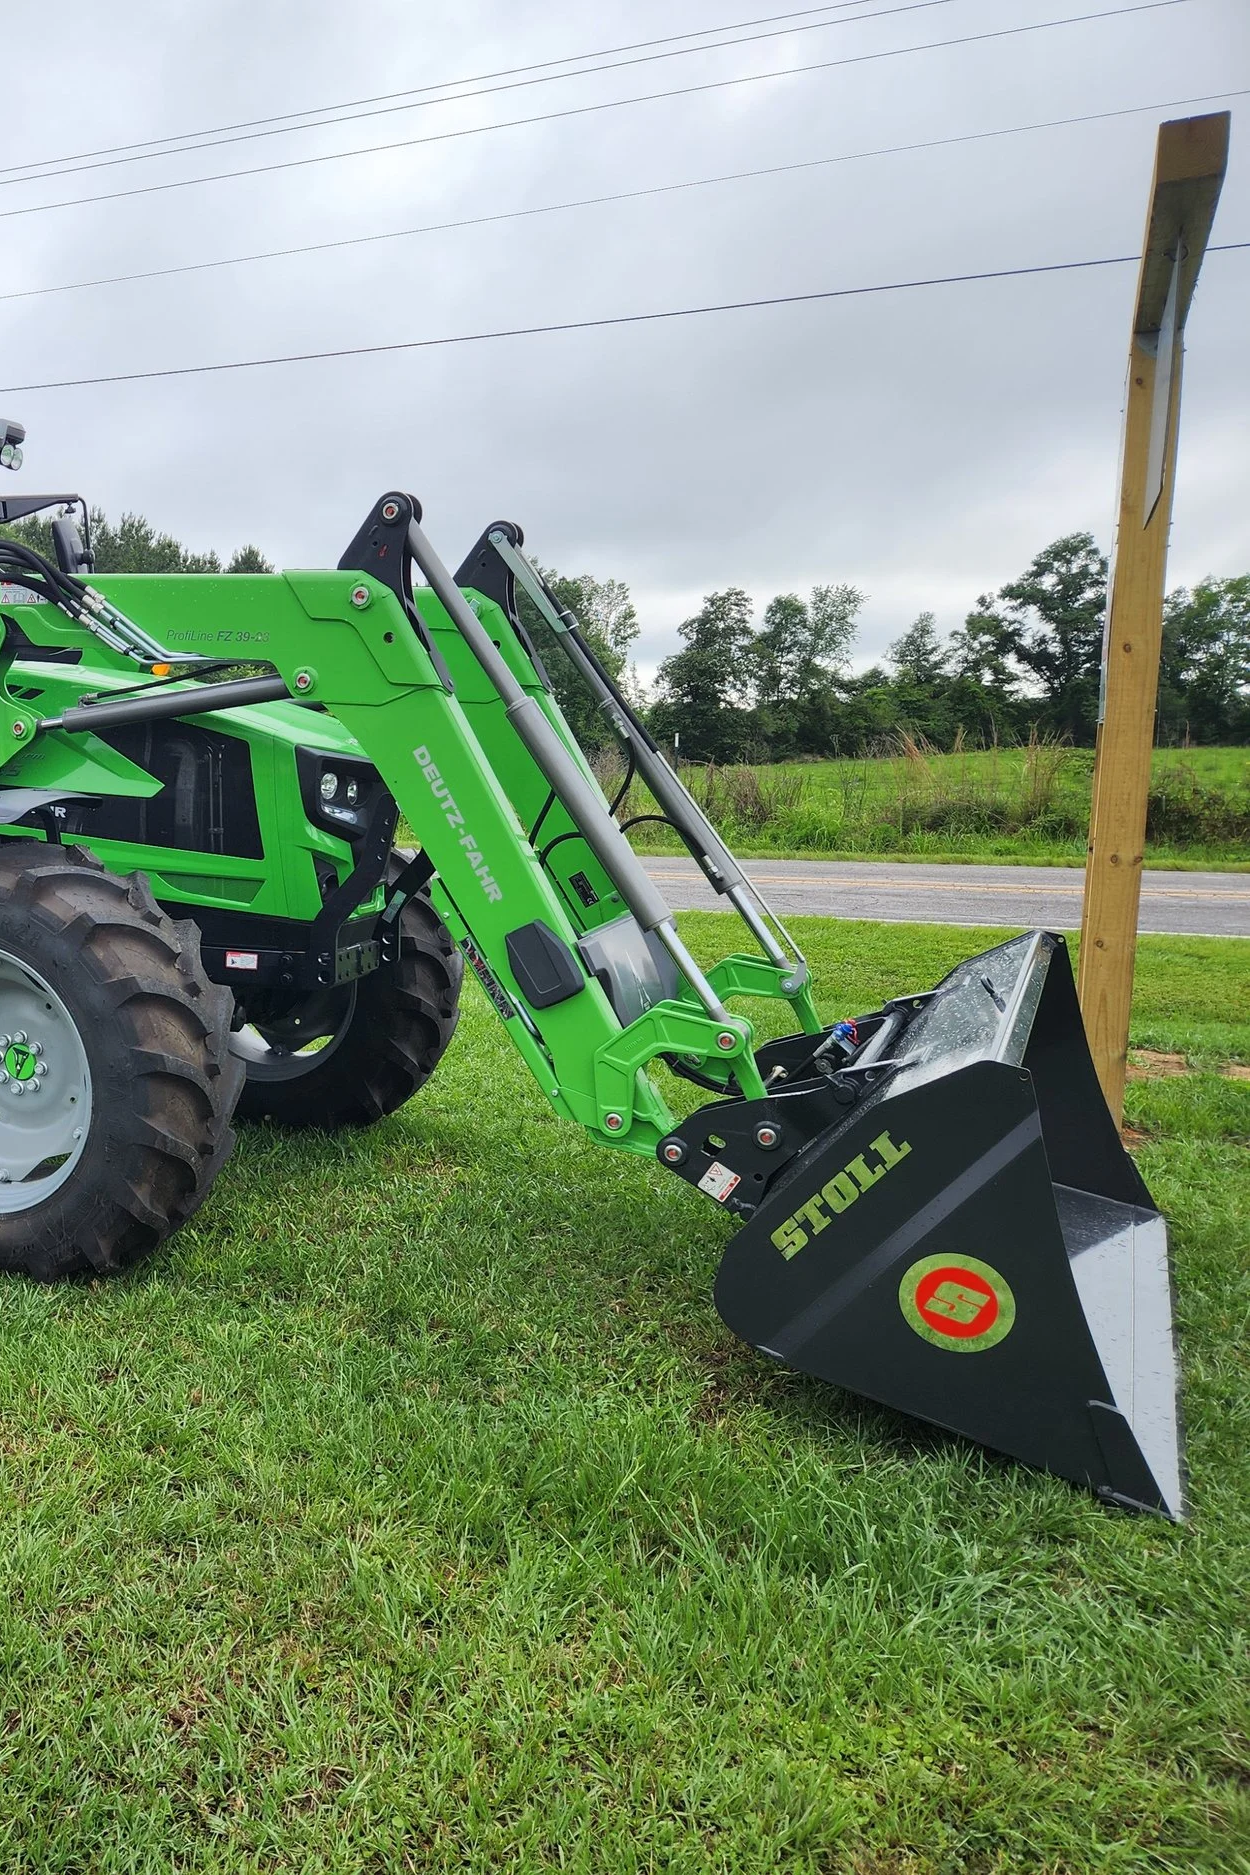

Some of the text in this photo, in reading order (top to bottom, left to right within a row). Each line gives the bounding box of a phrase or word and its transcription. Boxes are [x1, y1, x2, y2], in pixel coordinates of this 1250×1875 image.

[166, 629, 213, 642] ProfiLine
[216, 630, 233, 642] FZ
[412, 744, 503, 904] DEUTZ-FAHR
[770, 1129, 913, 1262] STOLL
